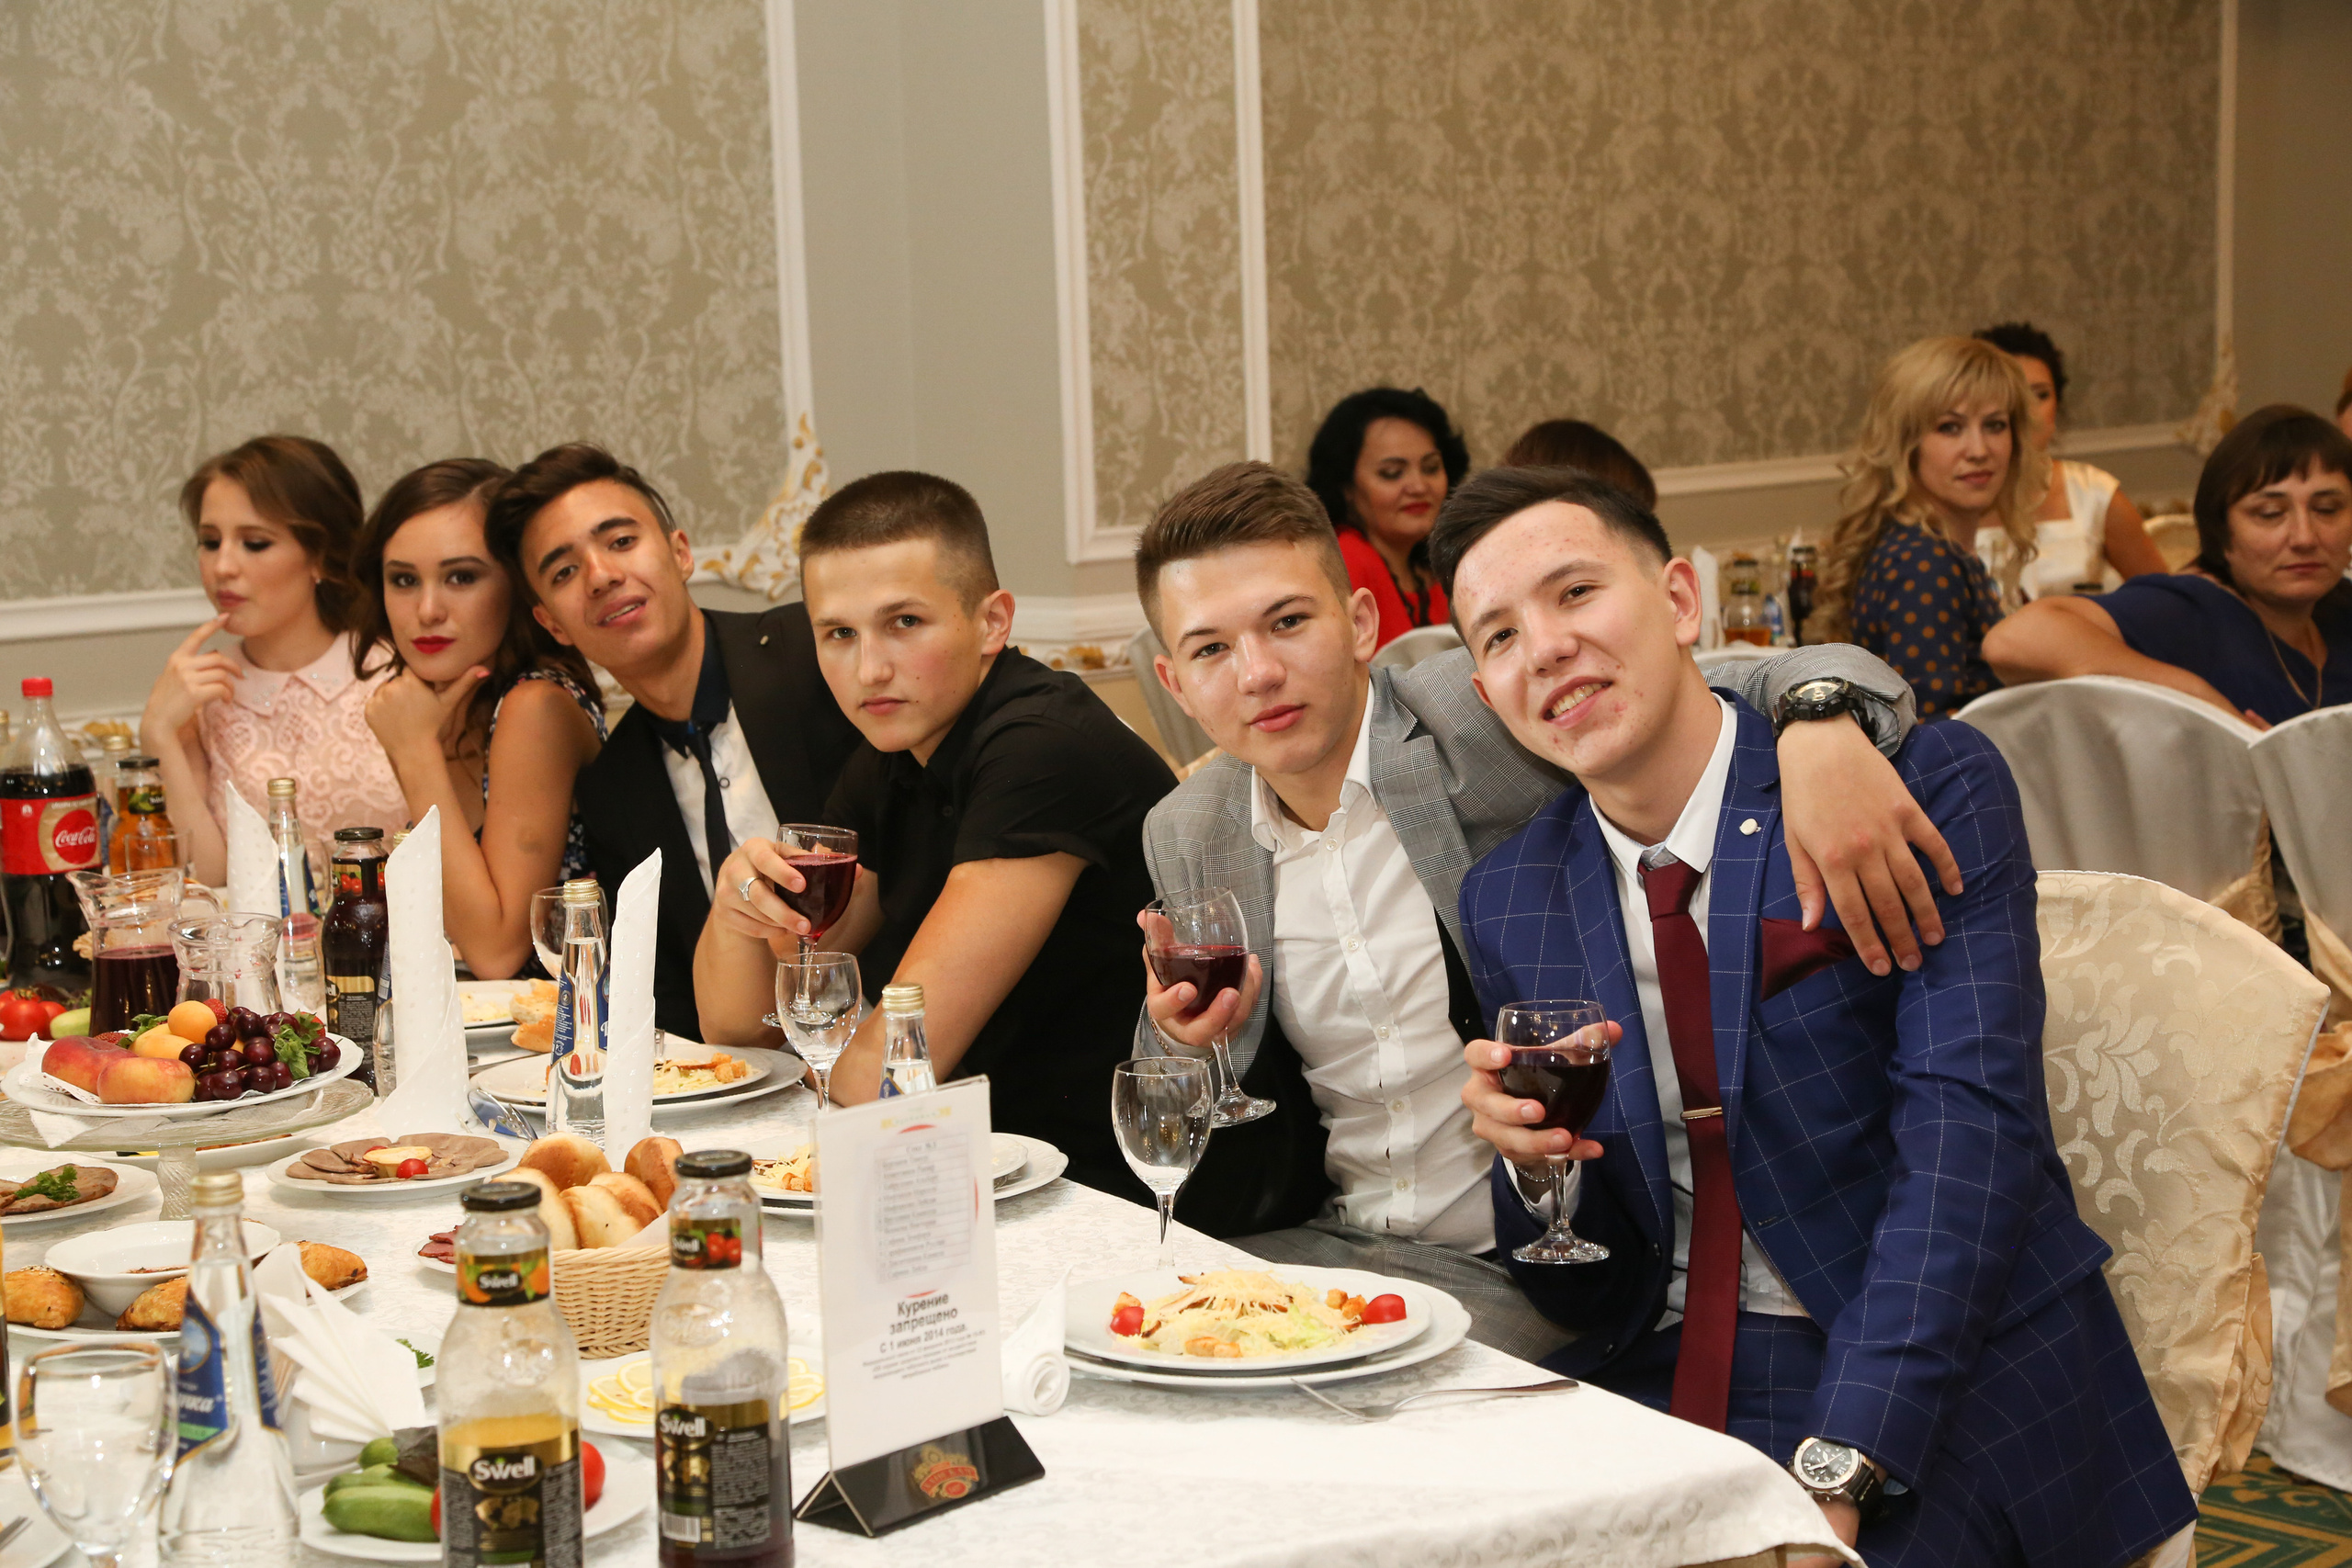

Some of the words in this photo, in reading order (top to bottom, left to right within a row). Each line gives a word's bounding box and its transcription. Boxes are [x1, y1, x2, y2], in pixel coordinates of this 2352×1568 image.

[479, 1272, 519, 1289] Swell
[897, 1293, 950, 1318] Курение
[889, 1306, 958, 1335] запрещено
[897, 1337, 922, 1349] июня
[924, 1327, 944, 1342] 2014
[660, 1413, 707, 1438] Swell
[473, 1455, 536, 1482] Swell
